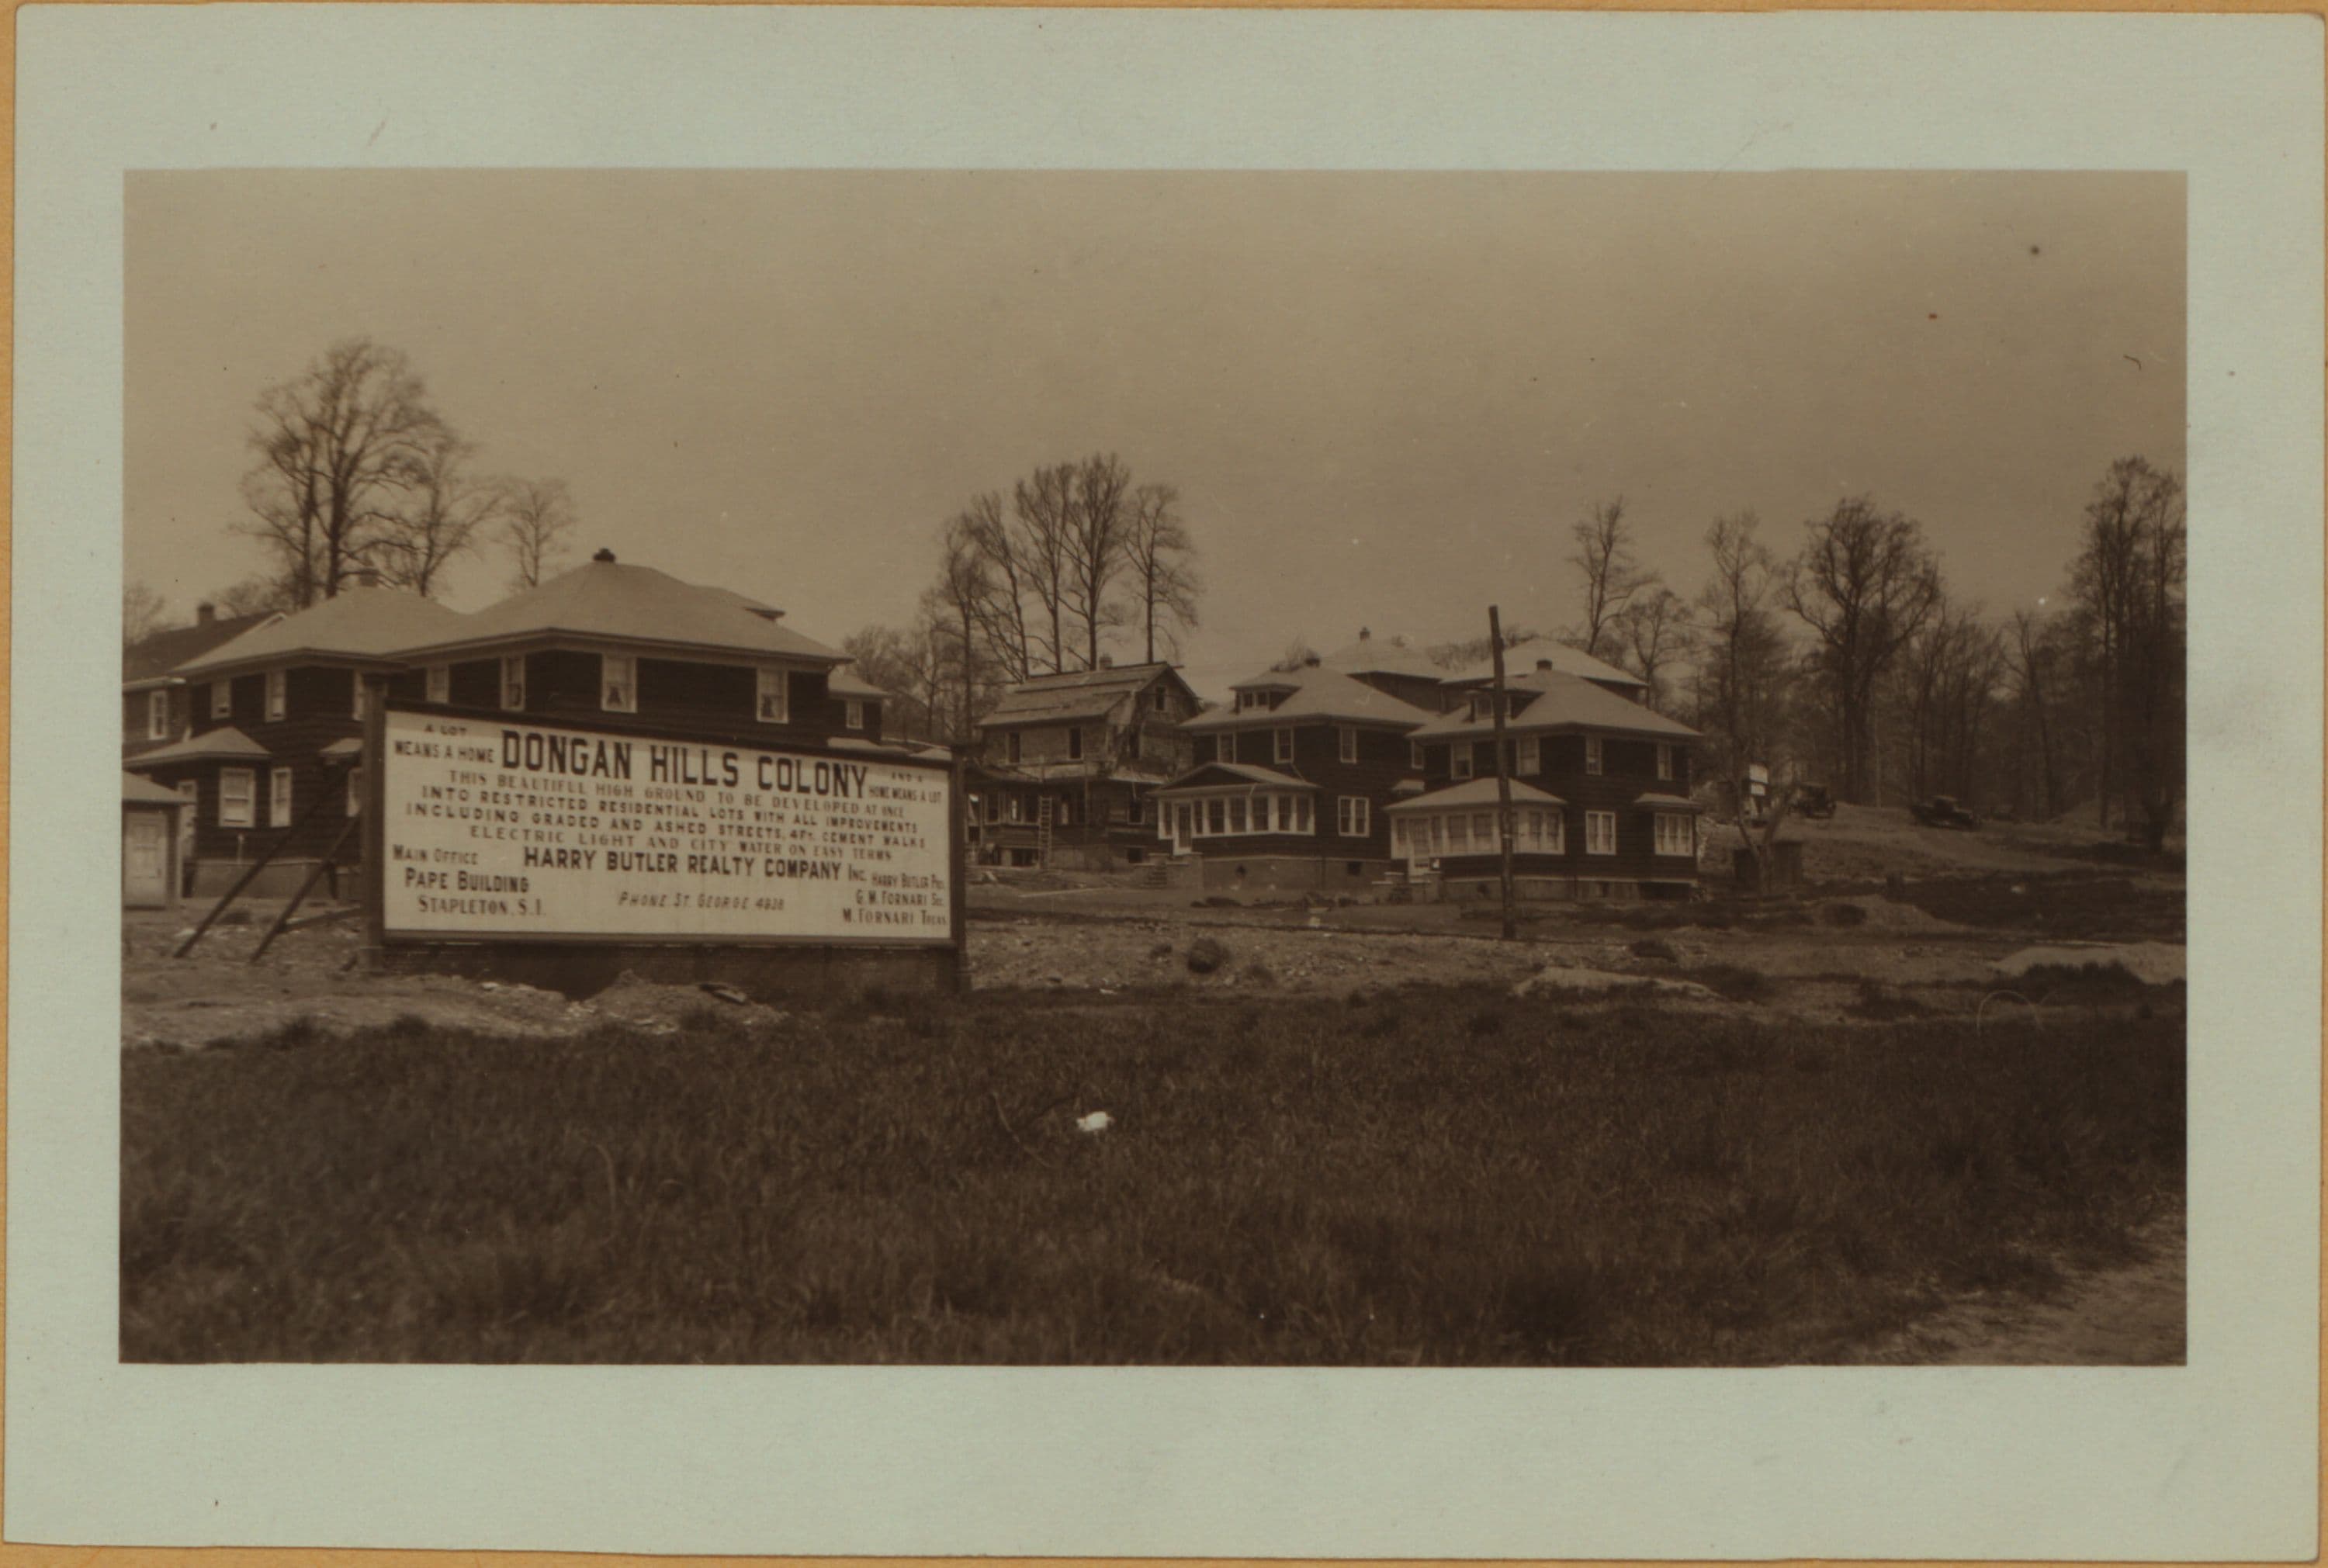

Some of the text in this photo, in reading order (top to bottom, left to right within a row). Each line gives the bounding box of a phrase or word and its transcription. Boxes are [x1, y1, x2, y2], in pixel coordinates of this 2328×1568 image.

[440, 725, 466, 736] LOT
[394, 740, 494, 763] MEANS A HOME
[502, 729, 868, 798] DONGAN HILLS COLONY
[422, 785, 918, 834] INTO RESTRICTED RESIDENTIAL LOTS WITH ALL IMPROVEMENTS
[450, 770, 487, 785] THIS
[596, 784, 633, 798] HIGH
[645, 787, 705, 802] GROUND
[719, 791, 734, 804] TO
[744, 794, 763, 807] BE
[772, 797, 858, 814] DEVELOPED
[865, 804, 877, 815] AT
[920, 790, 926, 802] A
[407, 802, 518, 823] INCLUDING
[532, 812, 599, 829] GRADED
[610, 819, 643, 831] AND
[655, 821, 707, 835] ASHED
[823, 832, 873, 846] CEMENT
[884, 836, 926, 849] WALKS
[470, 825, 892, 860] ELECTRIC LIGHT AND CITY WATER ON EASY TERMS
[404, 867, 529, 892] PAPE BUILDING
[524, 846, 596, 870] HARRY
[607, 851, 678, 874] BUTLER
[688, 855, 754, 877] REALTY
[764, 858, 842, 881] COMPANY
